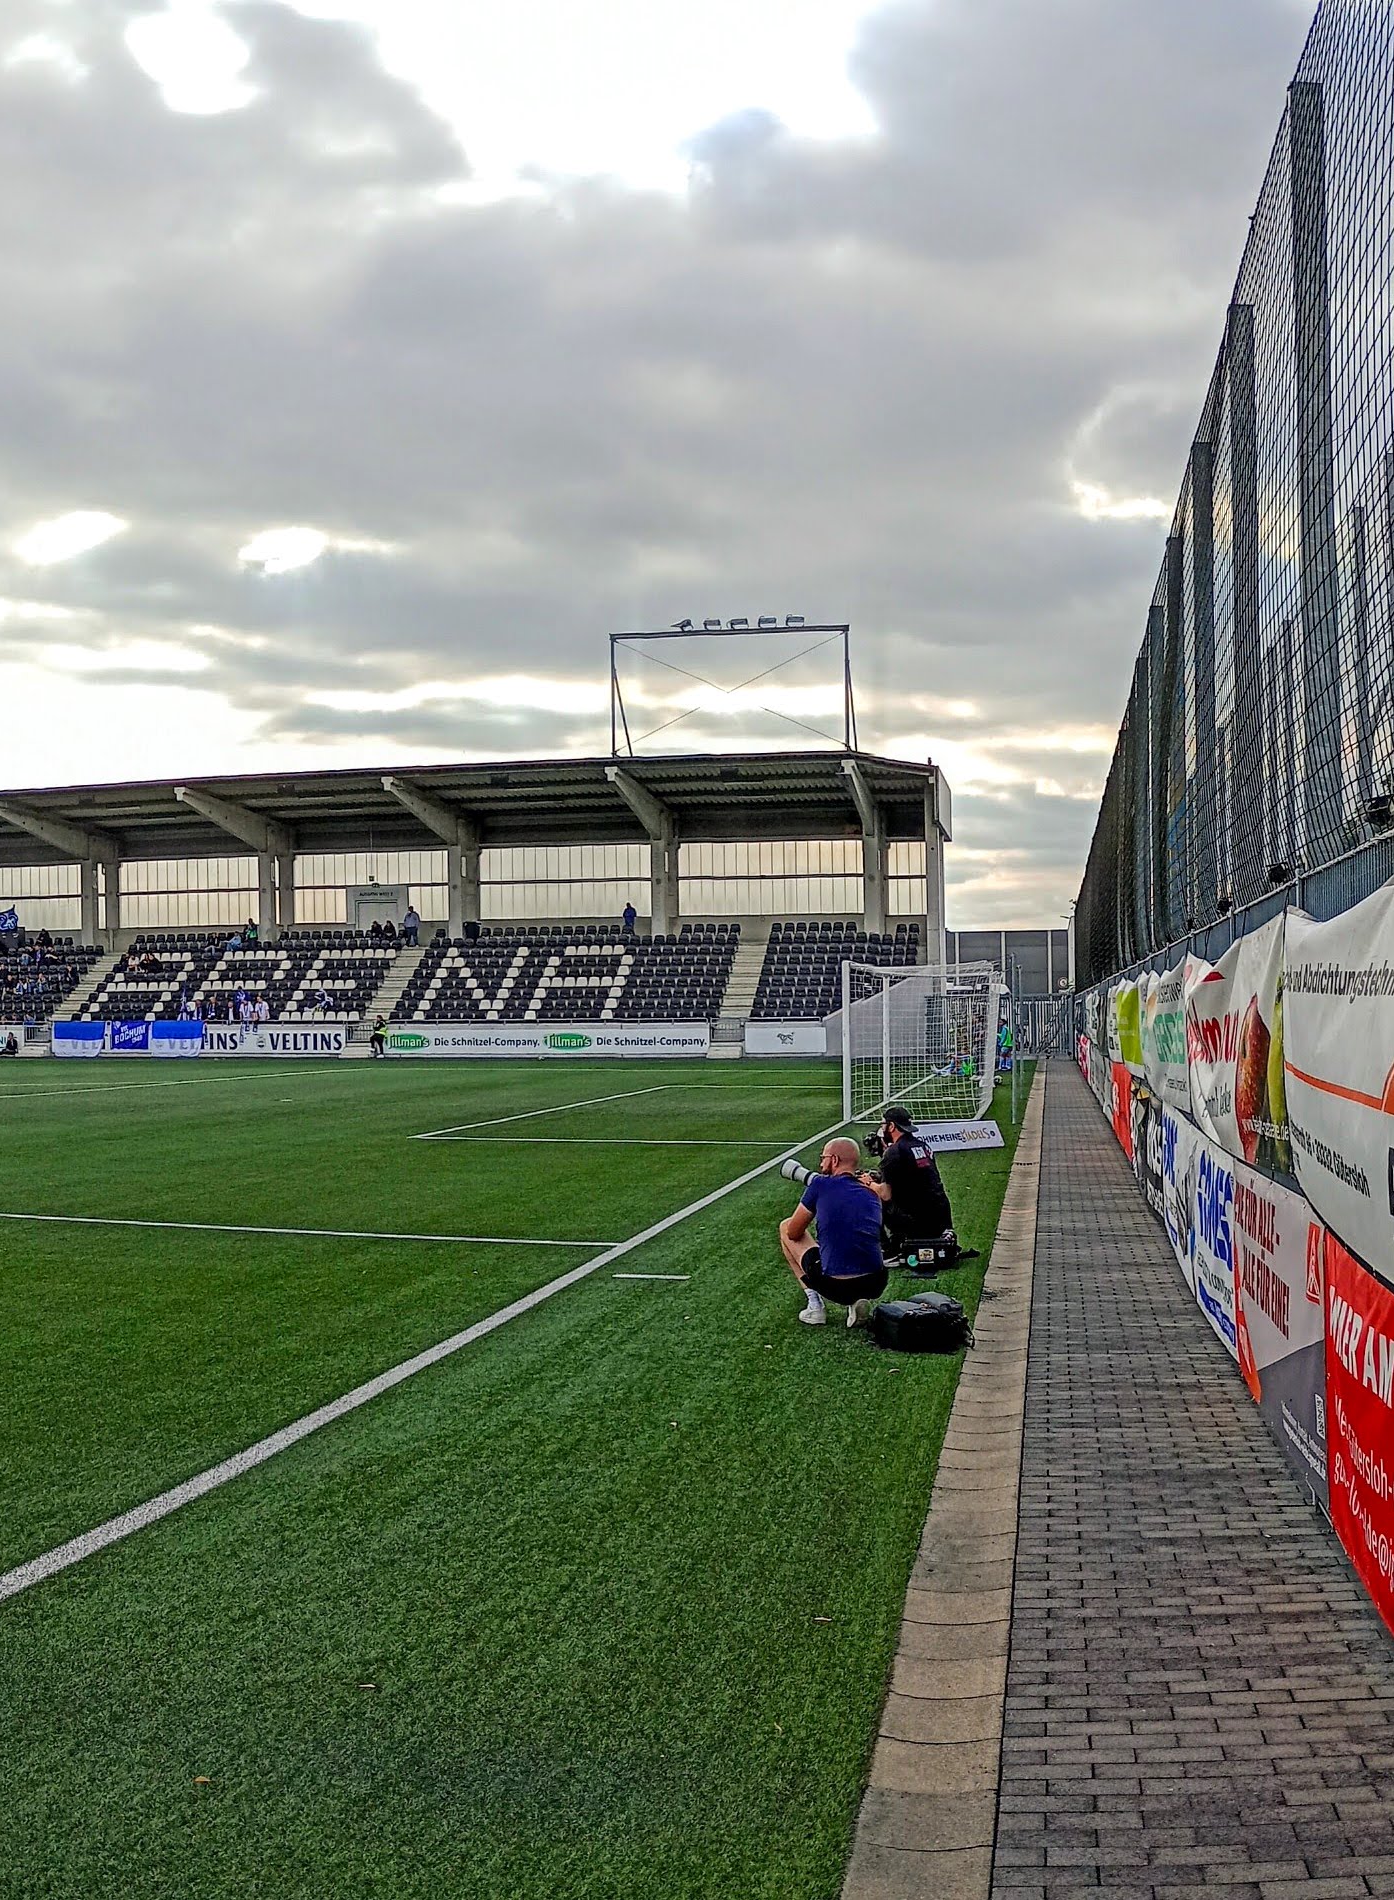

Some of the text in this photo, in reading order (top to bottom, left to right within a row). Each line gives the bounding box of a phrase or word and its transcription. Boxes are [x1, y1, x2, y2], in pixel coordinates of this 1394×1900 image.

[114, 1024, 146, 1045] BOCHUM
[268, 1032, 343, 1051] VELTINS
[434, 1036, 449, 1047] Die
[596, 1036, 612, 1047] Die
[1257, 1196, 1276, 1256] ALLE
[1256, 1247, 1271, 1319] FÜR
